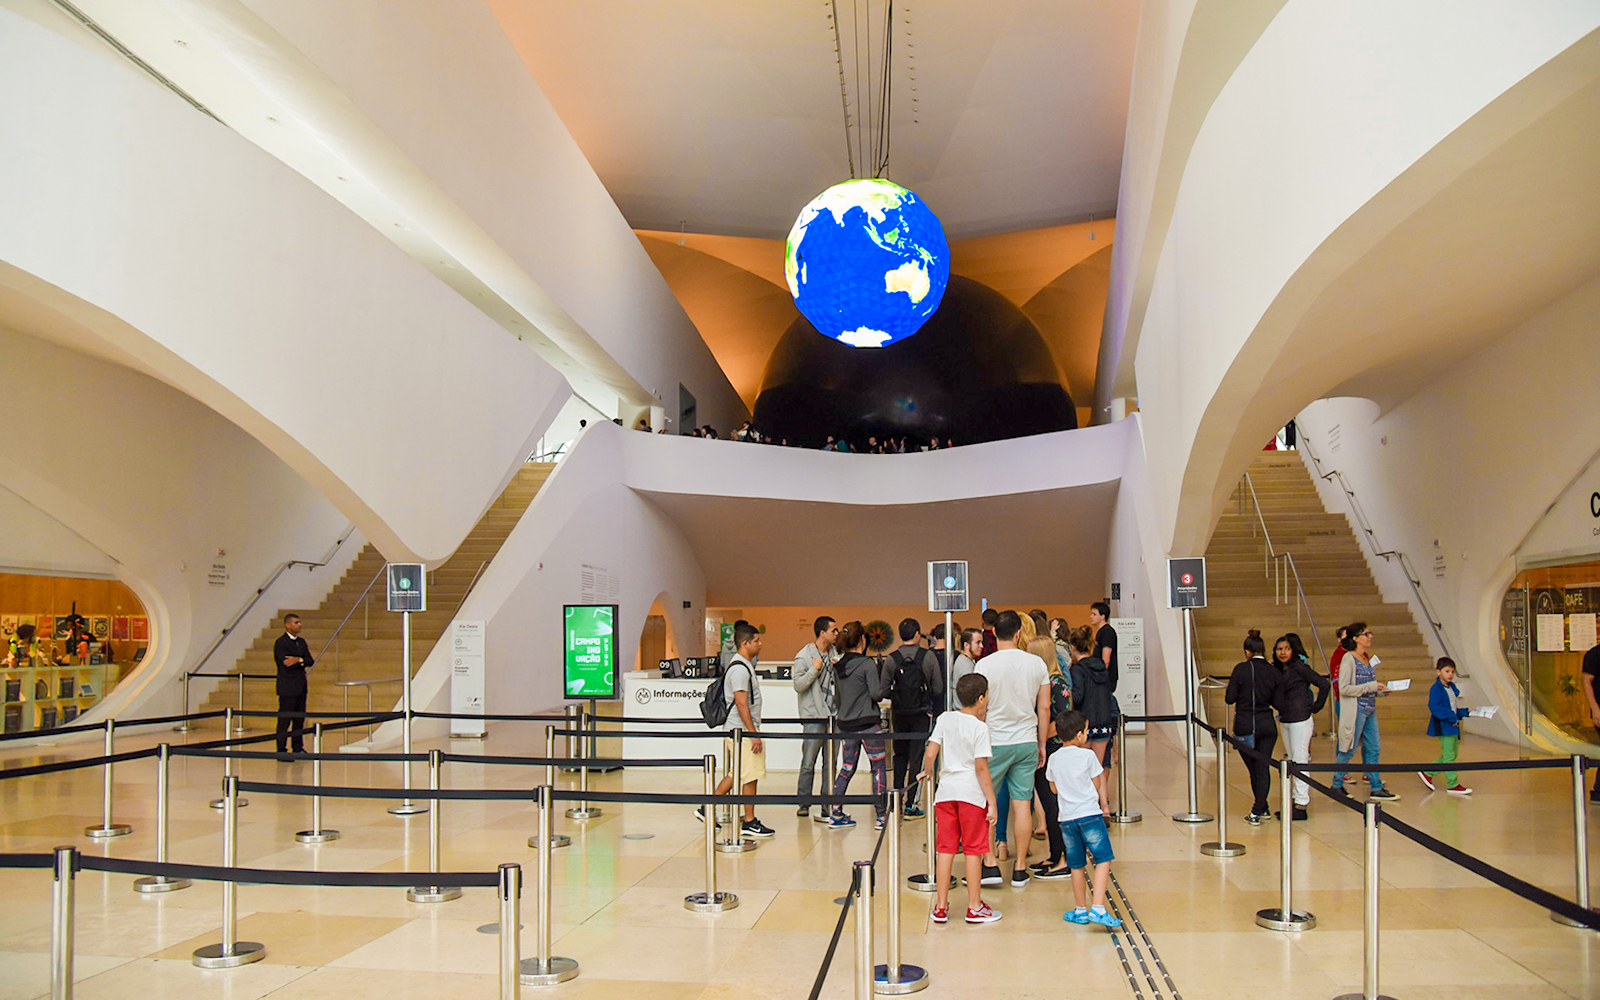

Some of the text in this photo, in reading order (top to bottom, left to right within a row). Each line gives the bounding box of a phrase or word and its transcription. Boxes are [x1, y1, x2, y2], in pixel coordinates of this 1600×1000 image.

[946, 578, 953, 586] 2
[1184, 574, 1190, 584] 3
[576, 638, 600, 646] CAMPO
[586, 646, 600, 654] INO
[684, 668, 695, 676] 01
[654, 689, 706, 699] Informações
